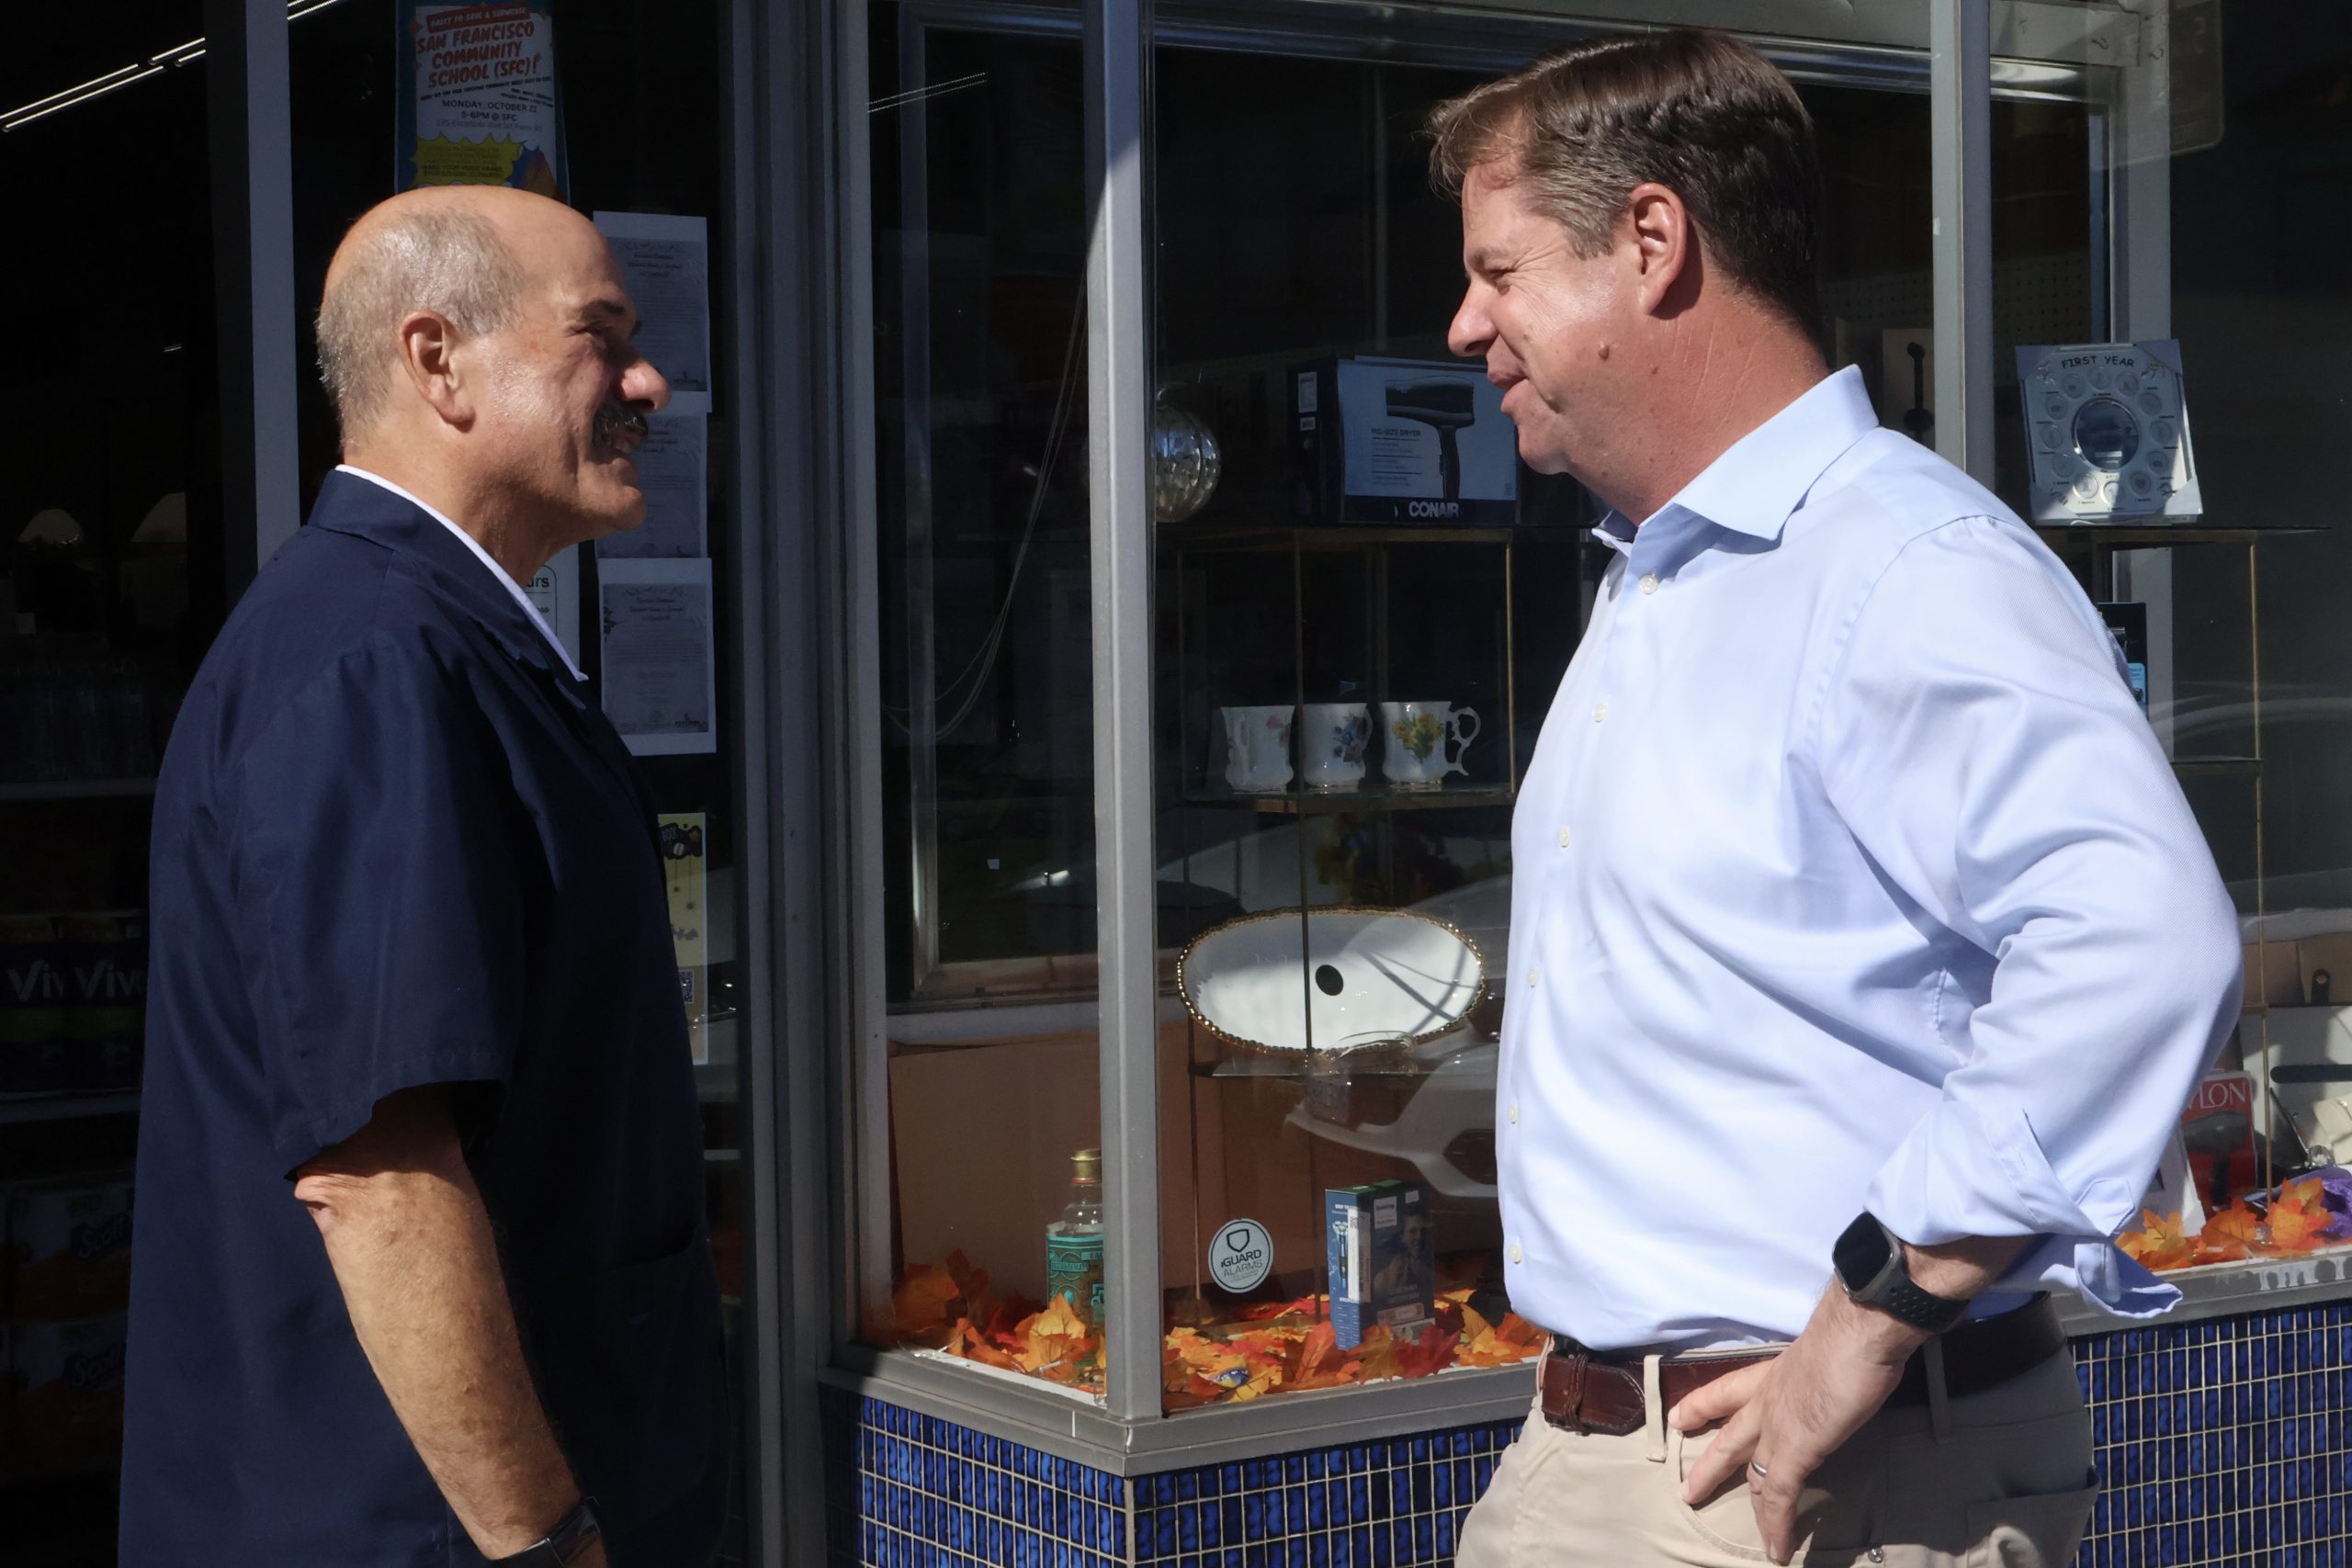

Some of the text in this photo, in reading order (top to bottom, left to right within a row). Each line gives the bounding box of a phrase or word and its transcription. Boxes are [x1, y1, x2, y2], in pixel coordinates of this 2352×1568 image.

[417, 21, 535, 53] SAN FRANCISCO
[432, 40, 523, 69] COMMUNITY
[428, 63, 489, 88] SCHOOL
[488, 101, 527, 111] OCTOBER
[461, 110, 517, 121] 5-6PM @ SFC
[2061, 355, 2134, 369] FIRST YEAR
[1408, 501, 1459, 518] CONAIR
[1223, 1258, 1263, 1278] ALARMS
